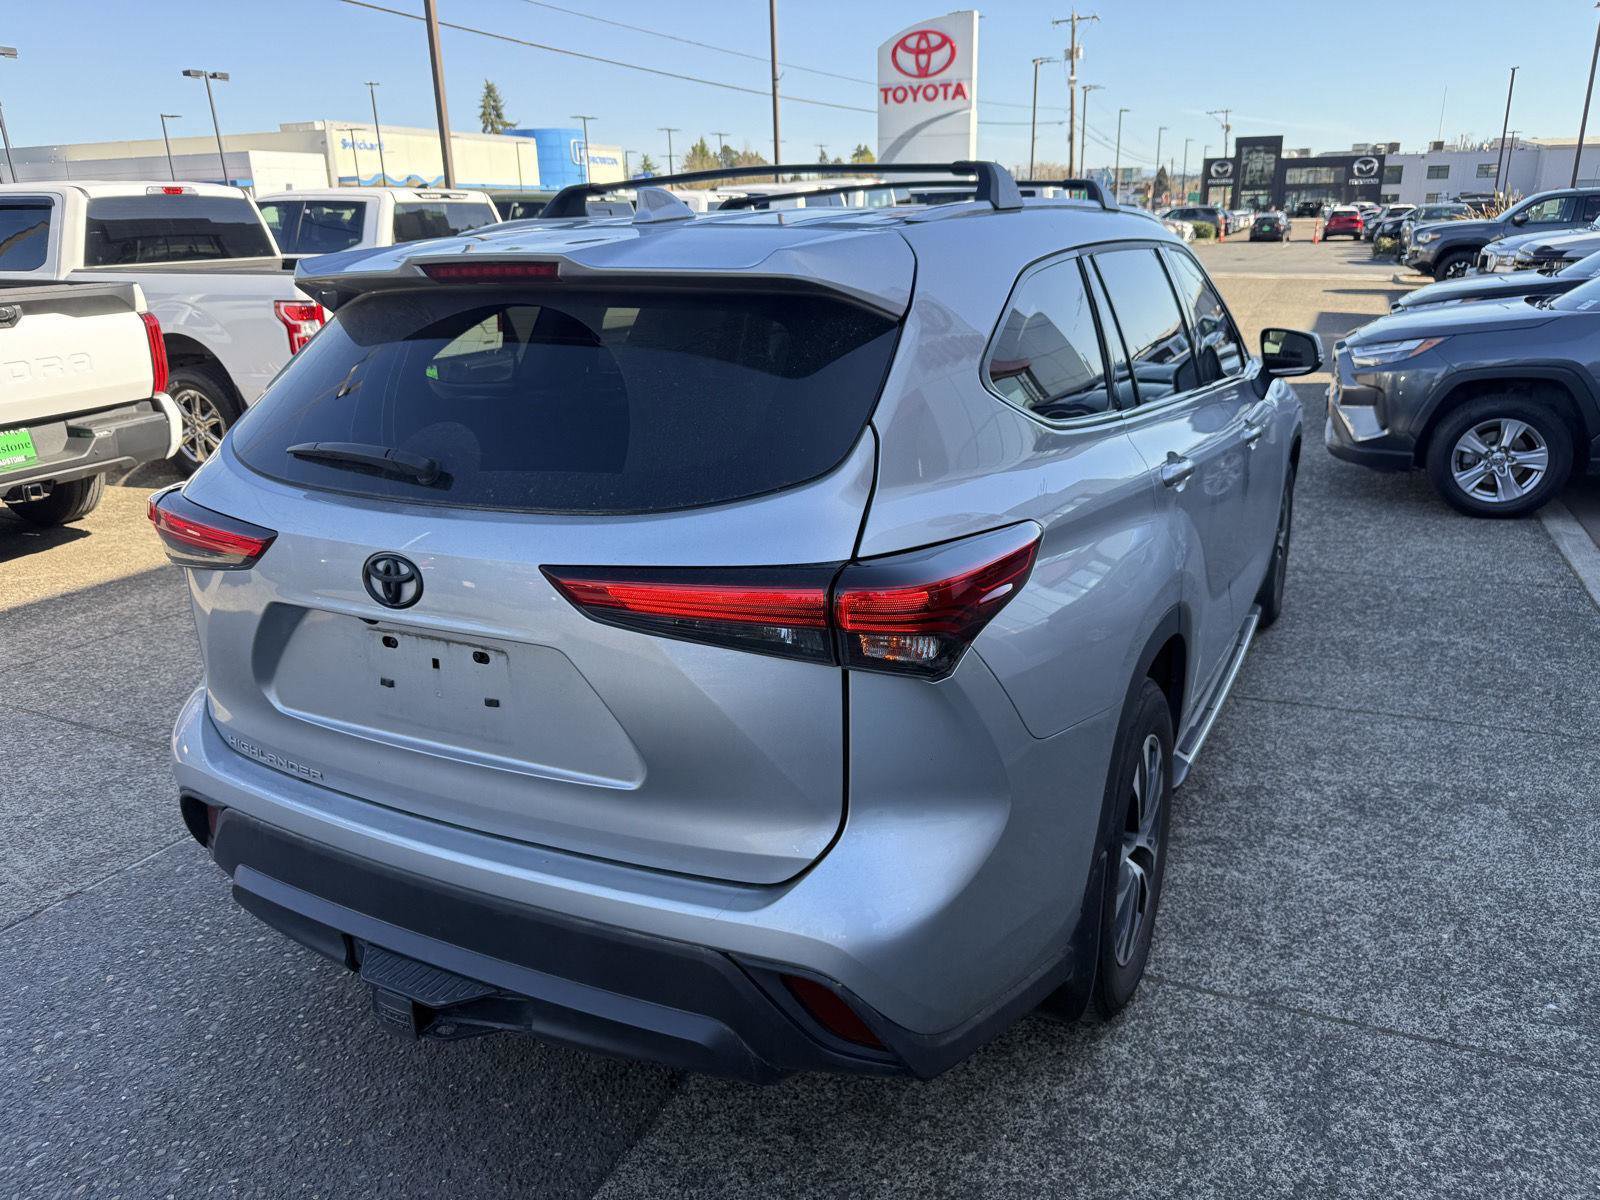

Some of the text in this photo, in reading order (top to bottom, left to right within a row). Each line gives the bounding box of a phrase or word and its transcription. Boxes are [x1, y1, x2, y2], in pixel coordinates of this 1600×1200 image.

[880, 82, 968, 105] TOYOTA
[0, 441, 31, 454] stone
[227, 734, 325, 782] HIGHLANDER
